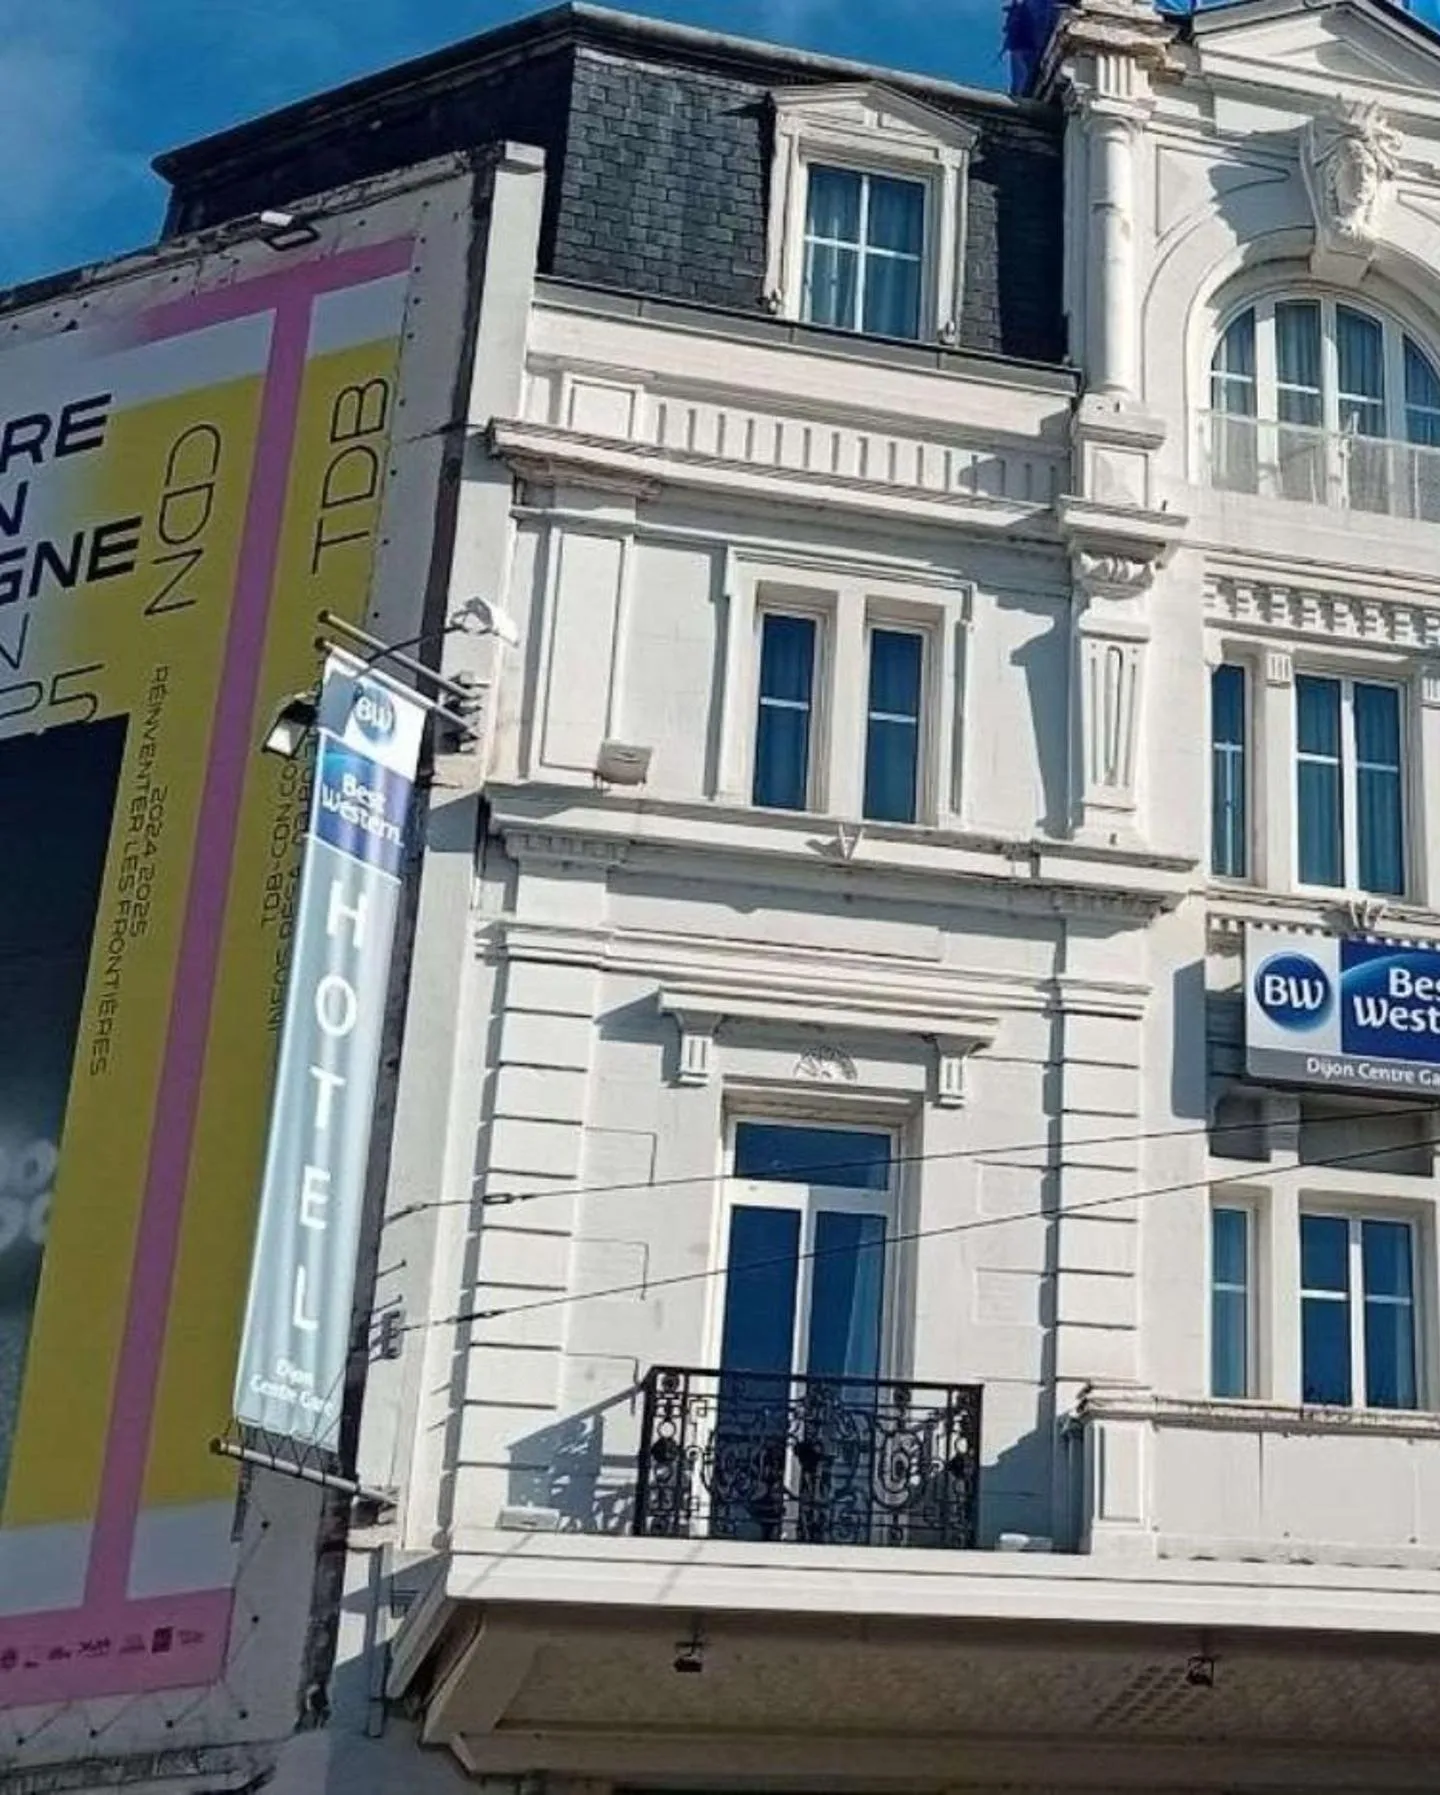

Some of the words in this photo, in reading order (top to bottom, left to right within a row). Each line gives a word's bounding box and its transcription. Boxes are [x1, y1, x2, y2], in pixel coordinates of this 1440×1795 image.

[313, 377, 390, 575] TDB
[144, 424, 221, 617] CDN
[354, 694, 394, 732] BW
[144, 785, 169, 858] 2024
[341, 771, 387, 817] Best
[118, 840, 139, 894] LES
[129, 865, 157, 938] 2025
[1263, 974, 1324, 1011] BW
[1306, 1057, 1355, 1080] Dijon
[1358, 1063, 1415, 1083] Centre
[292, 878, 368, 1332] HOTEL
